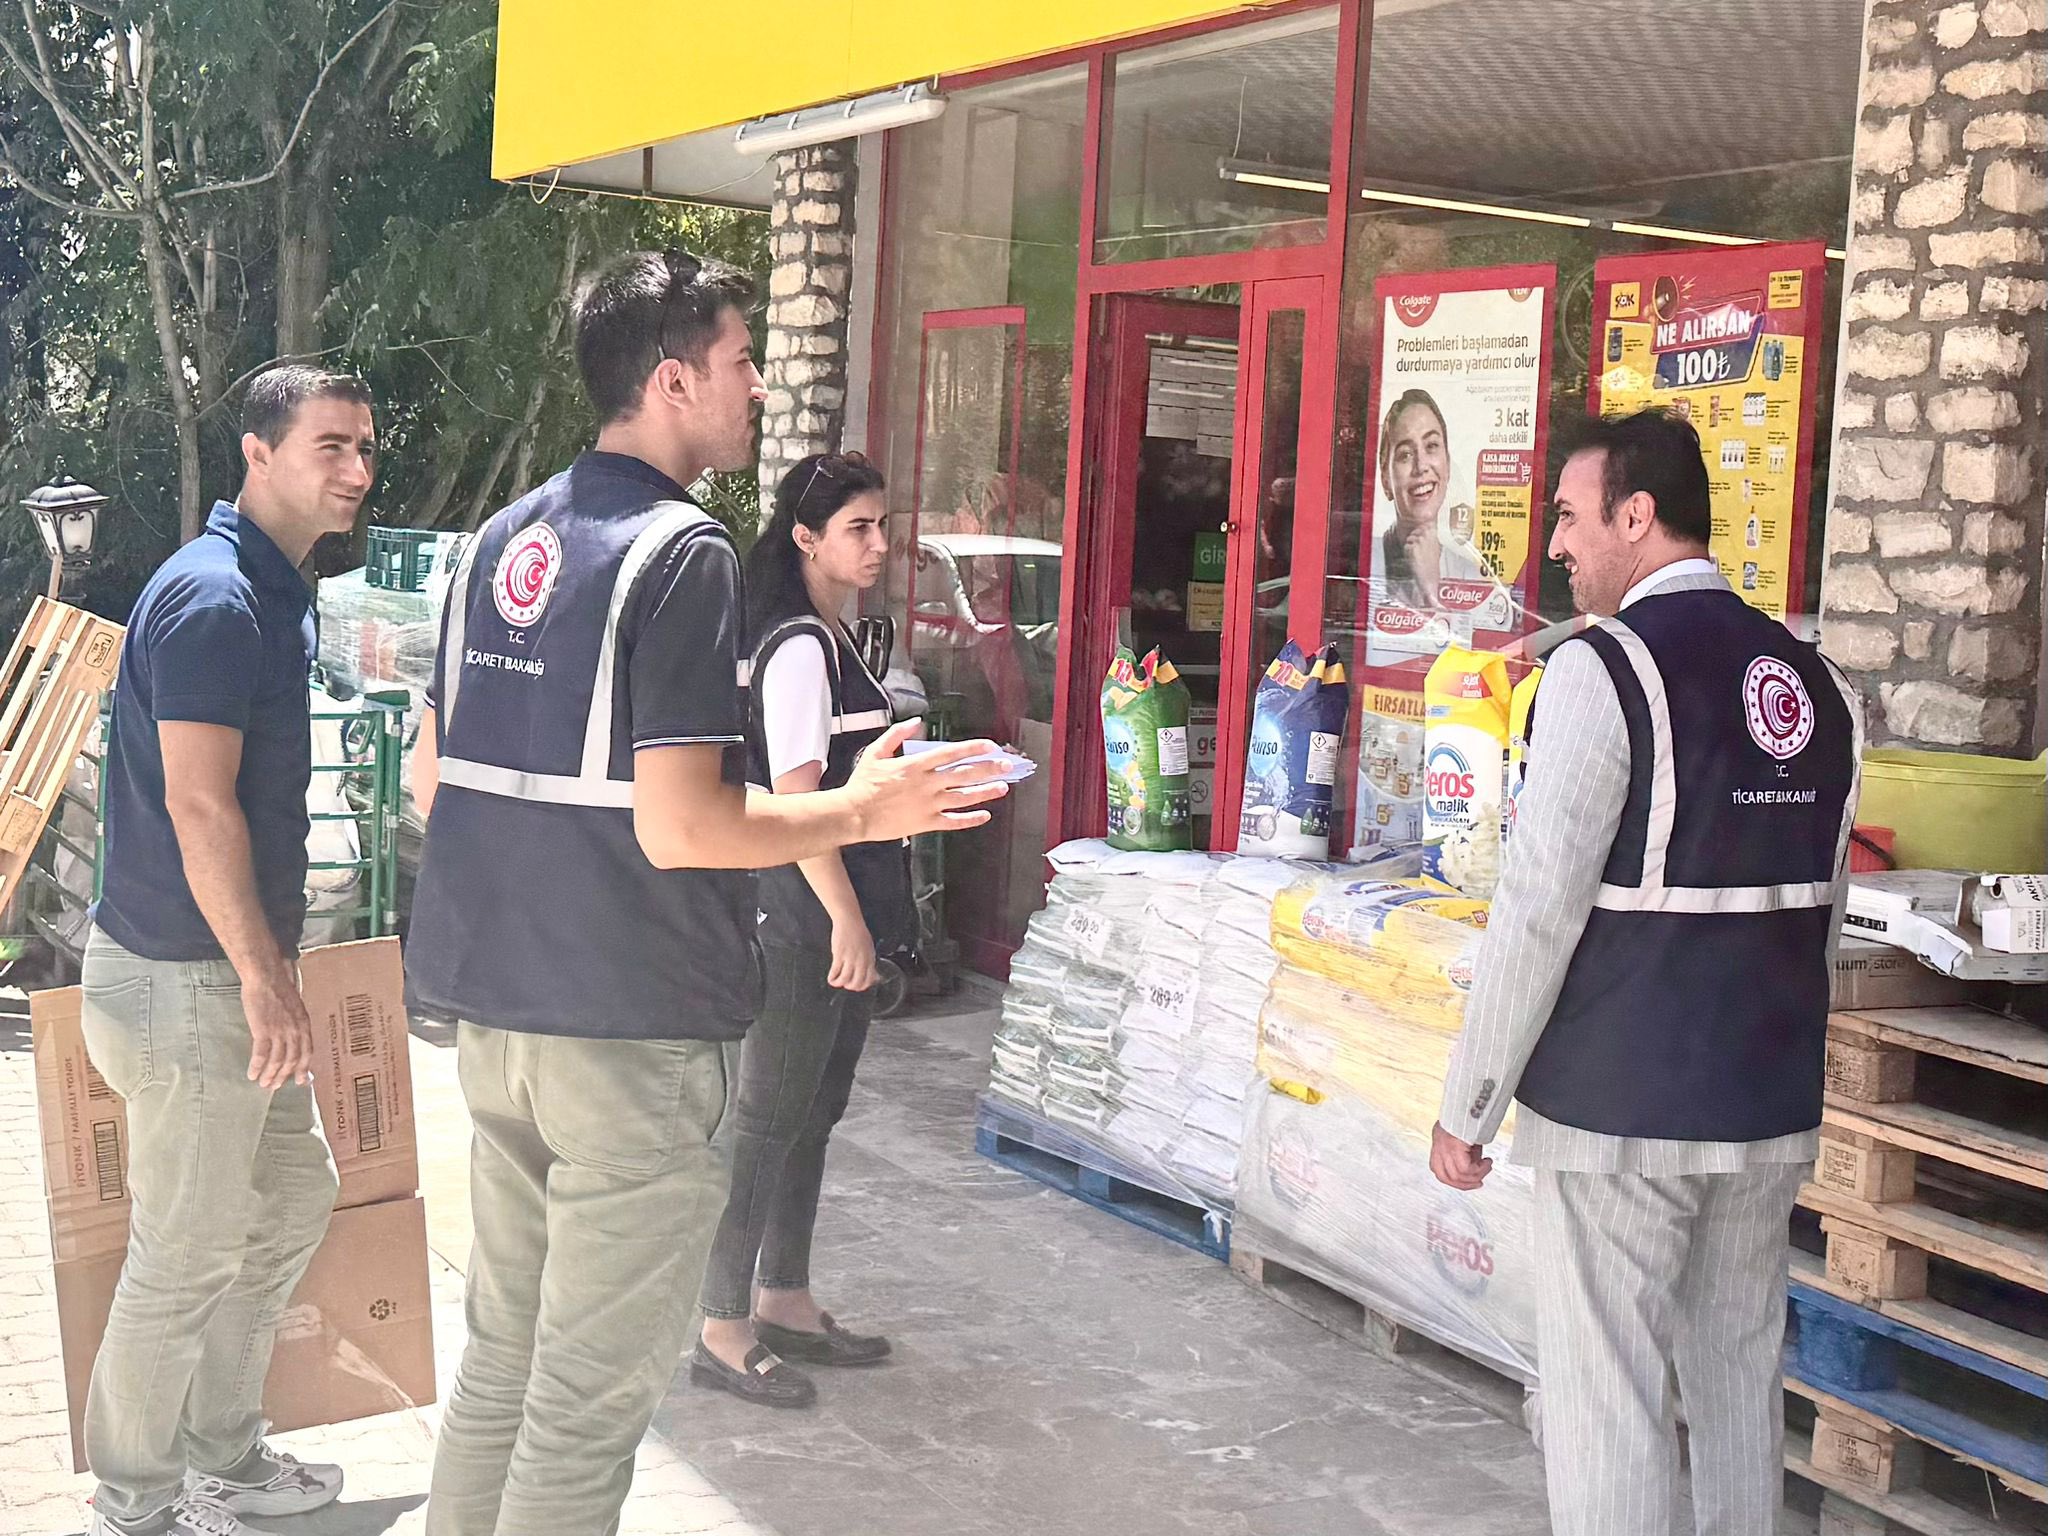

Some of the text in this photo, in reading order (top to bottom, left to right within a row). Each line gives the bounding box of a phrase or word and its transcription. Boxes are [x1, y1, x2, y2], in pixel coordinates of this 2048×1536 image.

[1399, 295, 1432, 307] Colgate
[1656, 323, 1678, 348] NE
[1682, 311, 1750, 342] ALIRSAN
[1397, 334, 1529, 354] Problemleri başlamadan
[1396, 353, 1537, 374] durdurmaya yardımcı olur
[1494, 408, 1530, 427] 3 kat
[1489, 431, 1507, 443] daha
[1457, 507, 1469, 522] 12
[1481, 531, 1500, 551] 199
[1439, 585, 1484, 604] Colgate
[1376, 610, 1424, 627] Colgate
[1732, 788, 1776, 804] TİCARET
